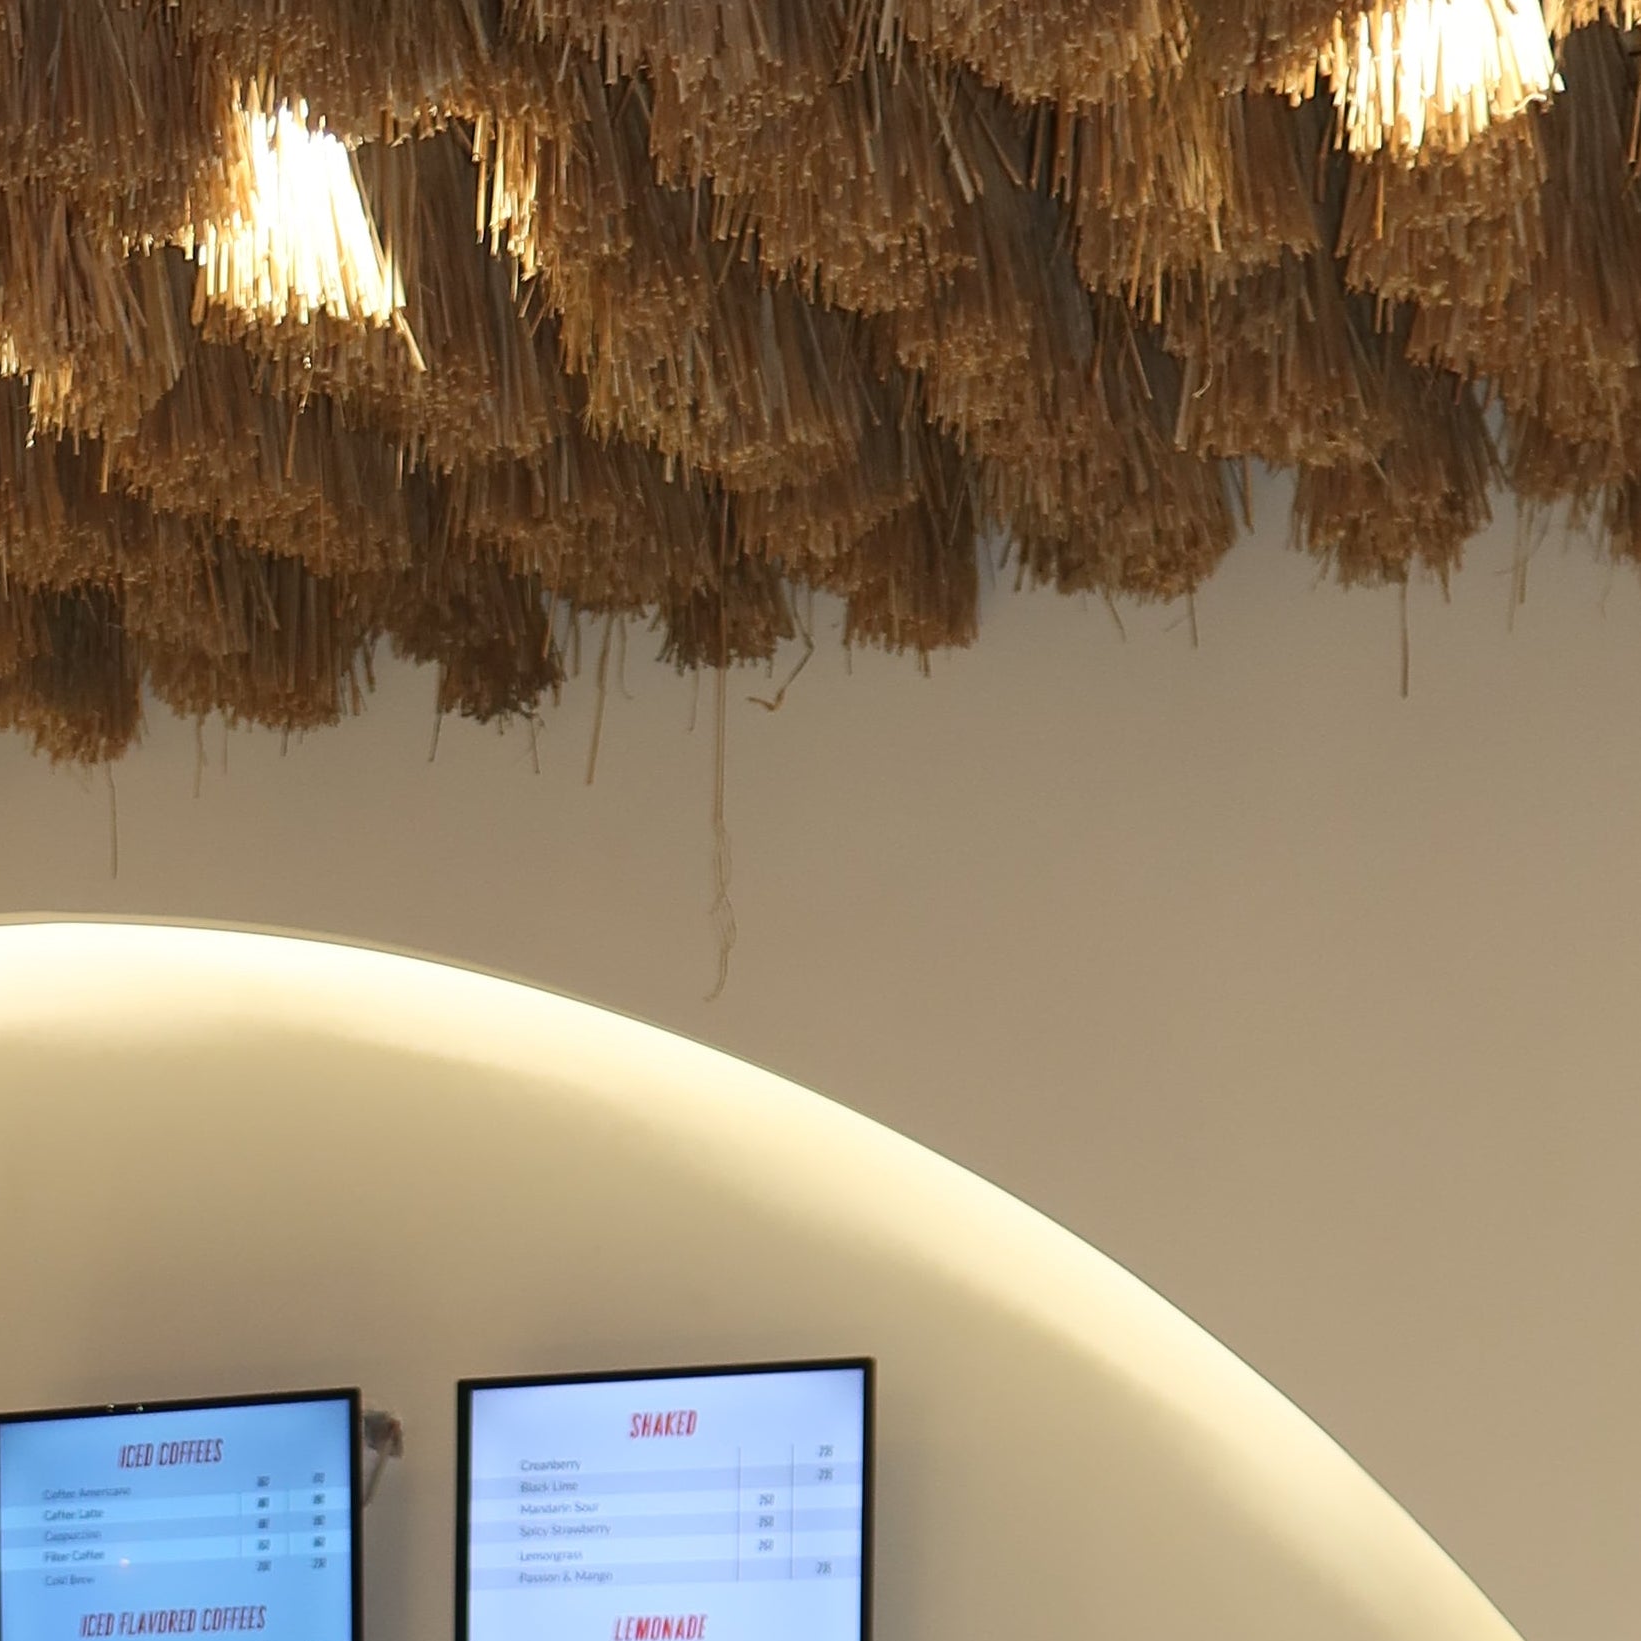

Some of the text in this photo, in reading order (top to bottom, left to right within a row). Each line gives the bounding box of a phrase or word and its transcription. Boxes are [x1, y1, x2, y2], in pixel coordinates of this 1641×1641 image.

[630, 1410, 697, 1438] SHAKED
[120, 1438, 223, 1469] ICED COFFEES
[520, 1482, 550, 1492] Black
[550, 1525, 611, 1535] Strawberry
[81, 1605, 266, 1638] ICED FLAVORED COFFEES
[613, 1614, 707, 1641] LEMONADE
